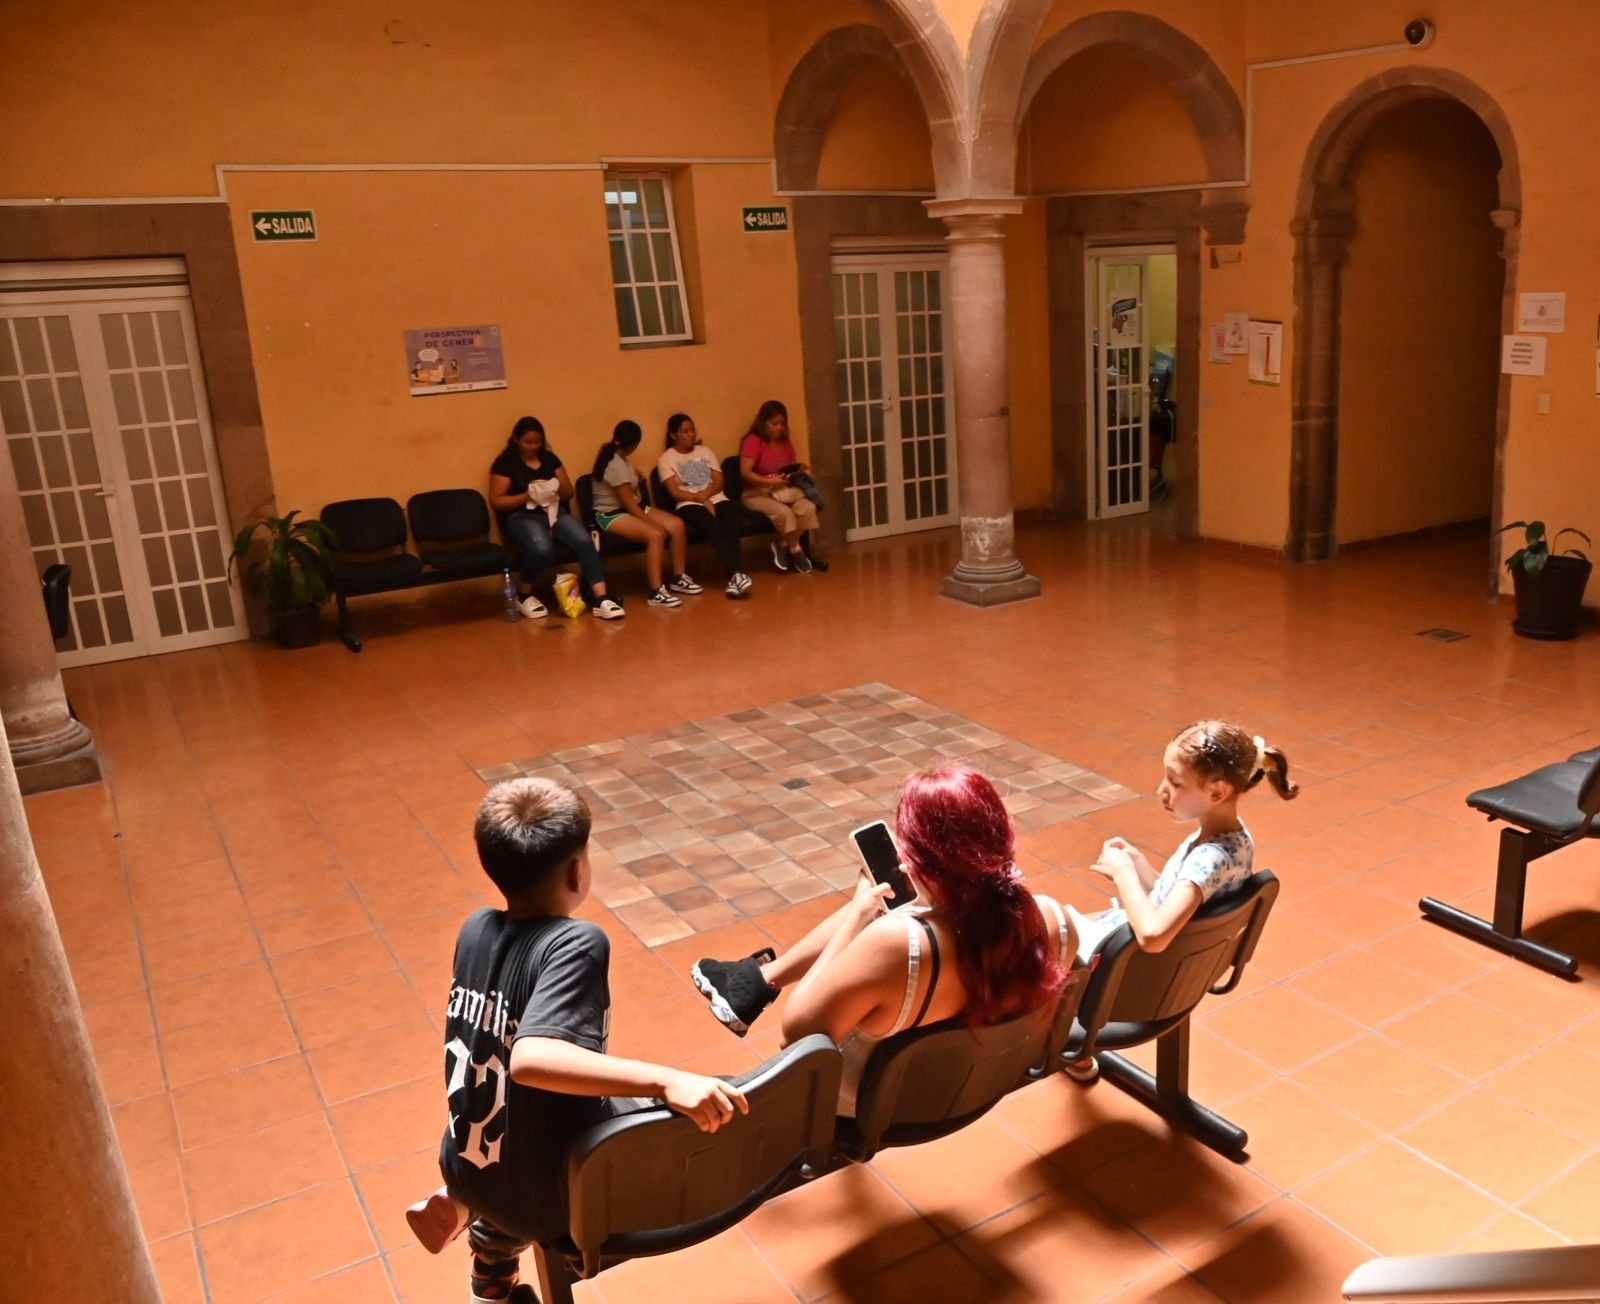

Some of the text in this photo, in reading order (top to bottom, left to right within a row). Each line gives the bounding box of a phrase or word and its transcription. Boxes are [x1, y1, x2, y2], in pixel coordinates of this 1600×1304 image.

[757, 211, 787, 226] SALIDA
[271, 217, 313, 234] SALIDA
[424, 329, 481, 339] PERSPECTIVA
[425, 340, 440, 348] DE
